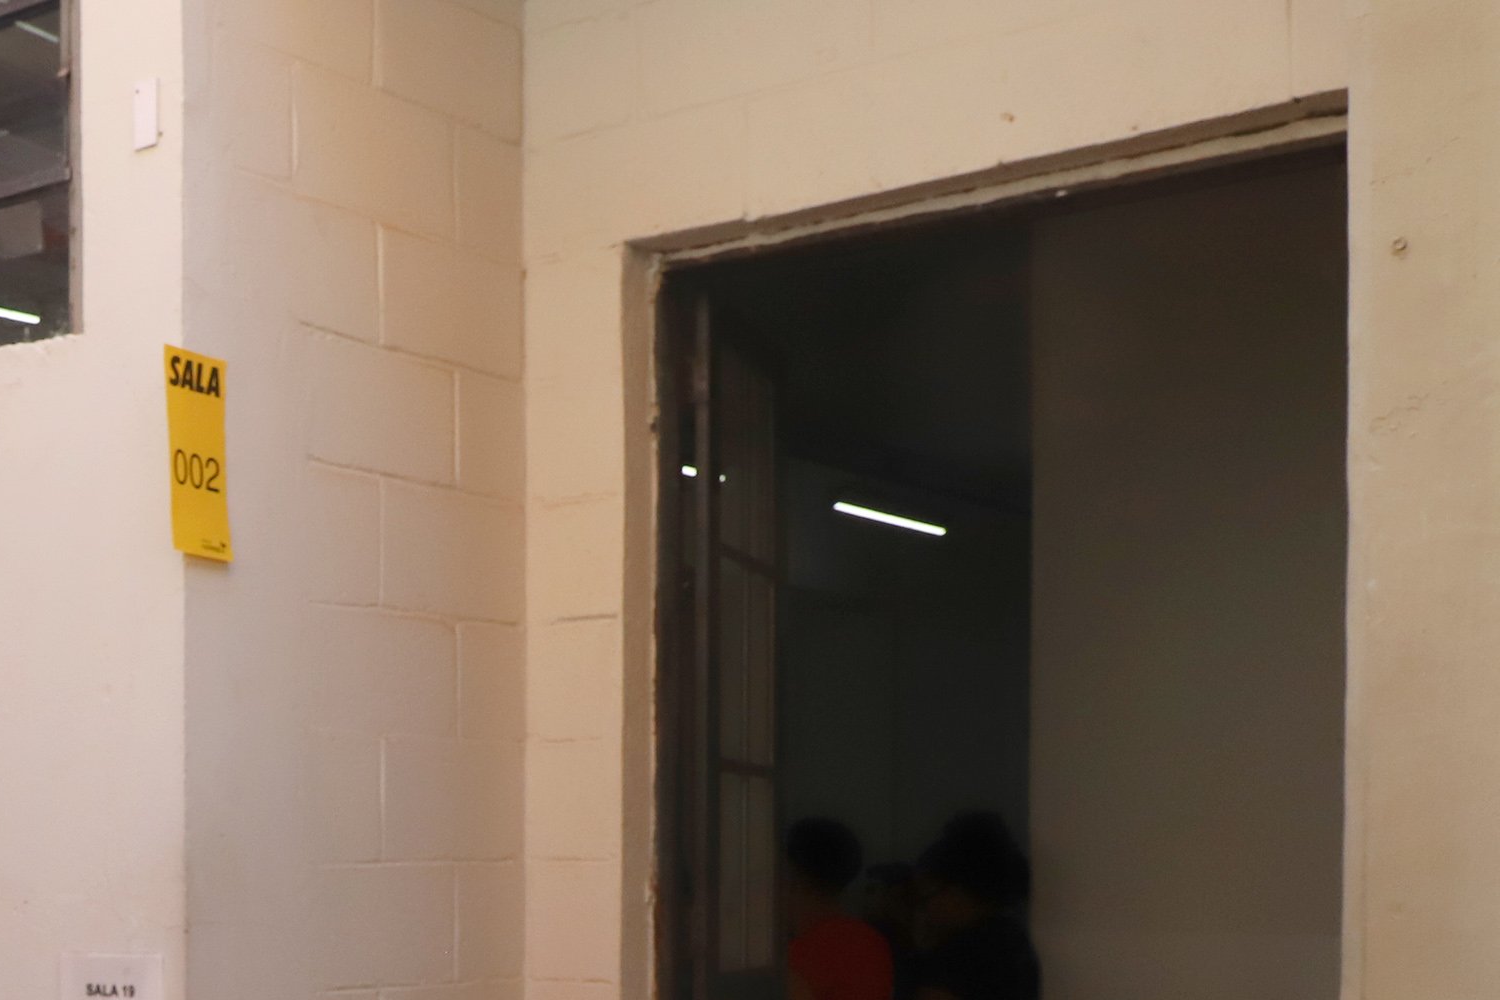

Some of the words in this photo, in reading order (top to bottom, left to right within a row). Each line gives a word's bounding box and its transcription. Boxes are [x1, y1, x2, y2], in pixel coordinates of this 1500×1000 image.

[169, 355, 220, 398] SALA
[173, 448, 220, 493] 002
[86, 983, 118, 997] SALA
